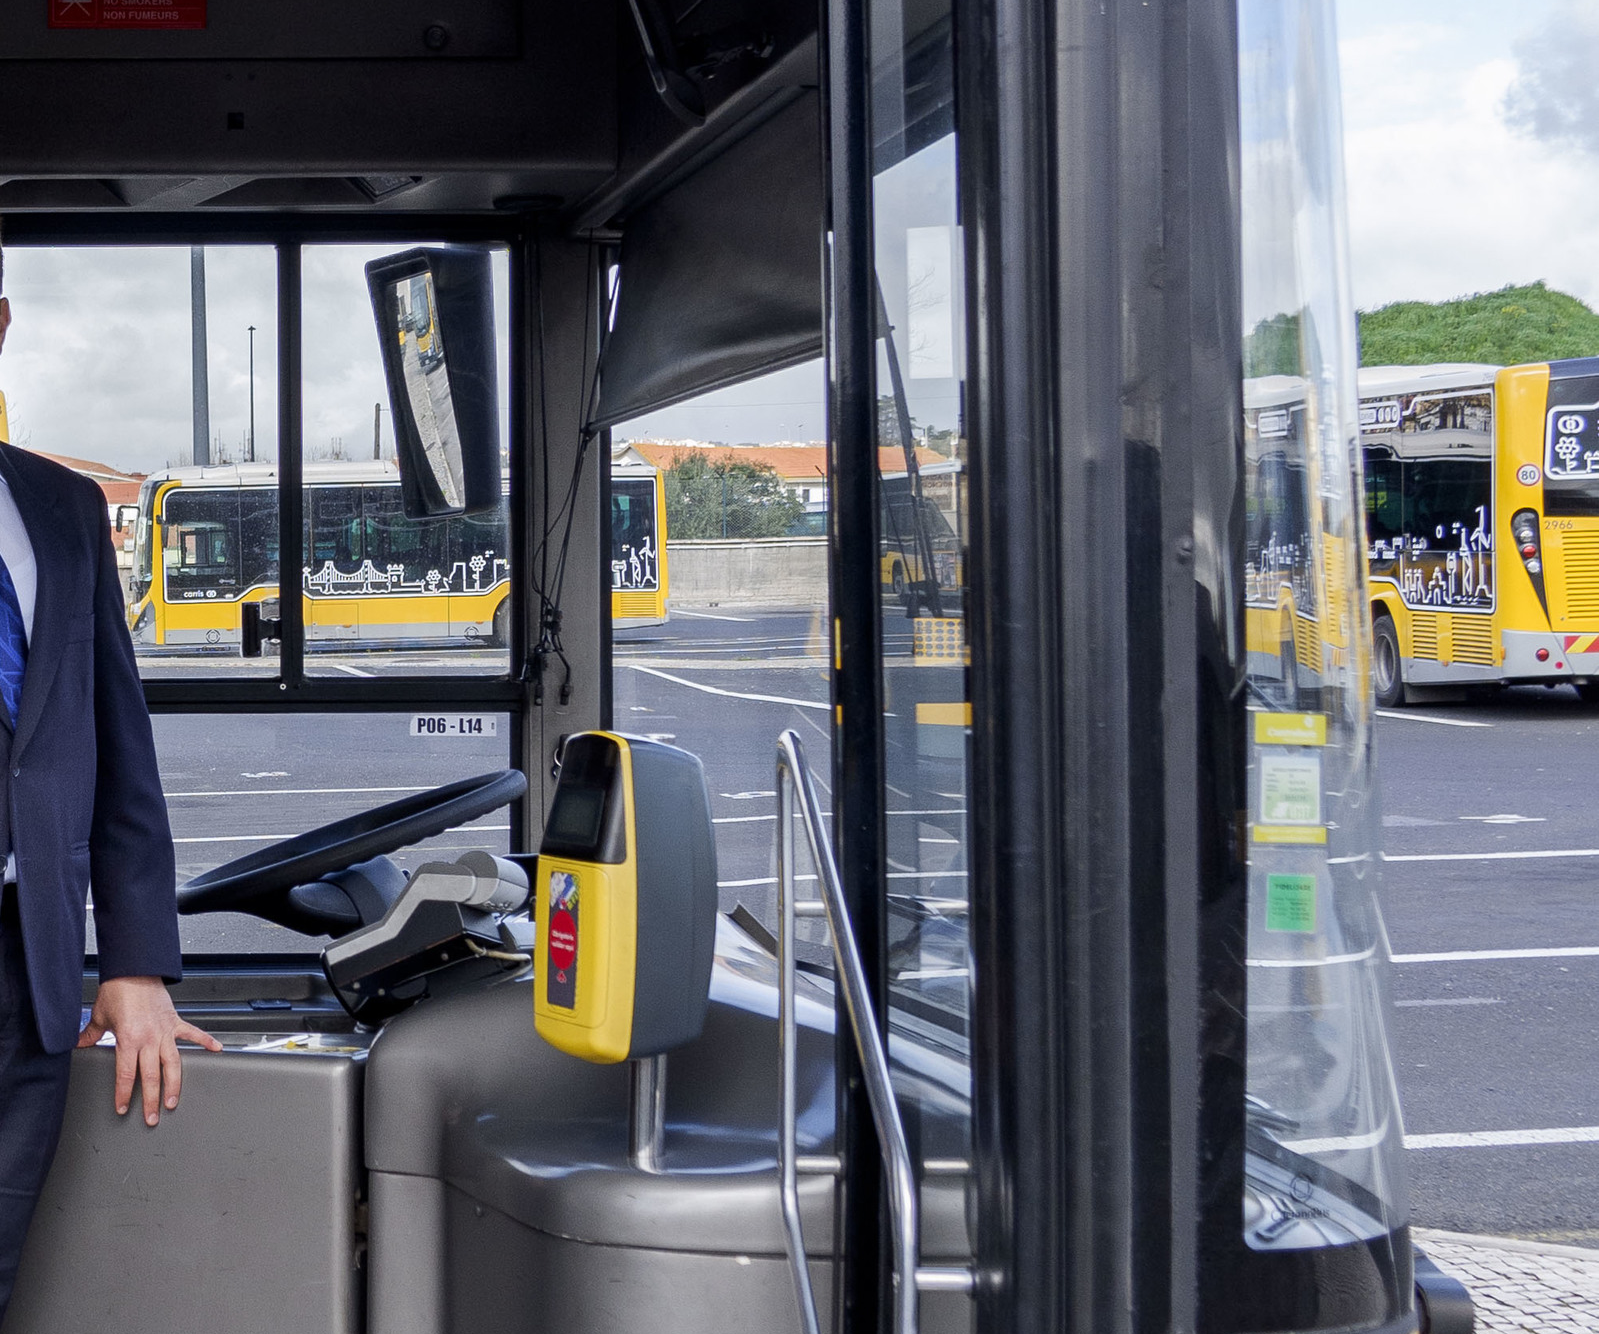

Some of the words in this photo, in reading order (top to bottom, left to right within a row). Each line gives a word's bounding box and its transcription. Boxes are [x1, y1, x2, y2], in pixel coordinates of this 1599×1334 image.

[103, 10, 126, 21] NON
[128, 10, 180, 21] FUMEURS
[1520, 469, 1536, 481] 80
[1544, 520, 1573, 530] 2966
[417, 717, 446, 734] P06
[458, 717, 483, 734] L14
